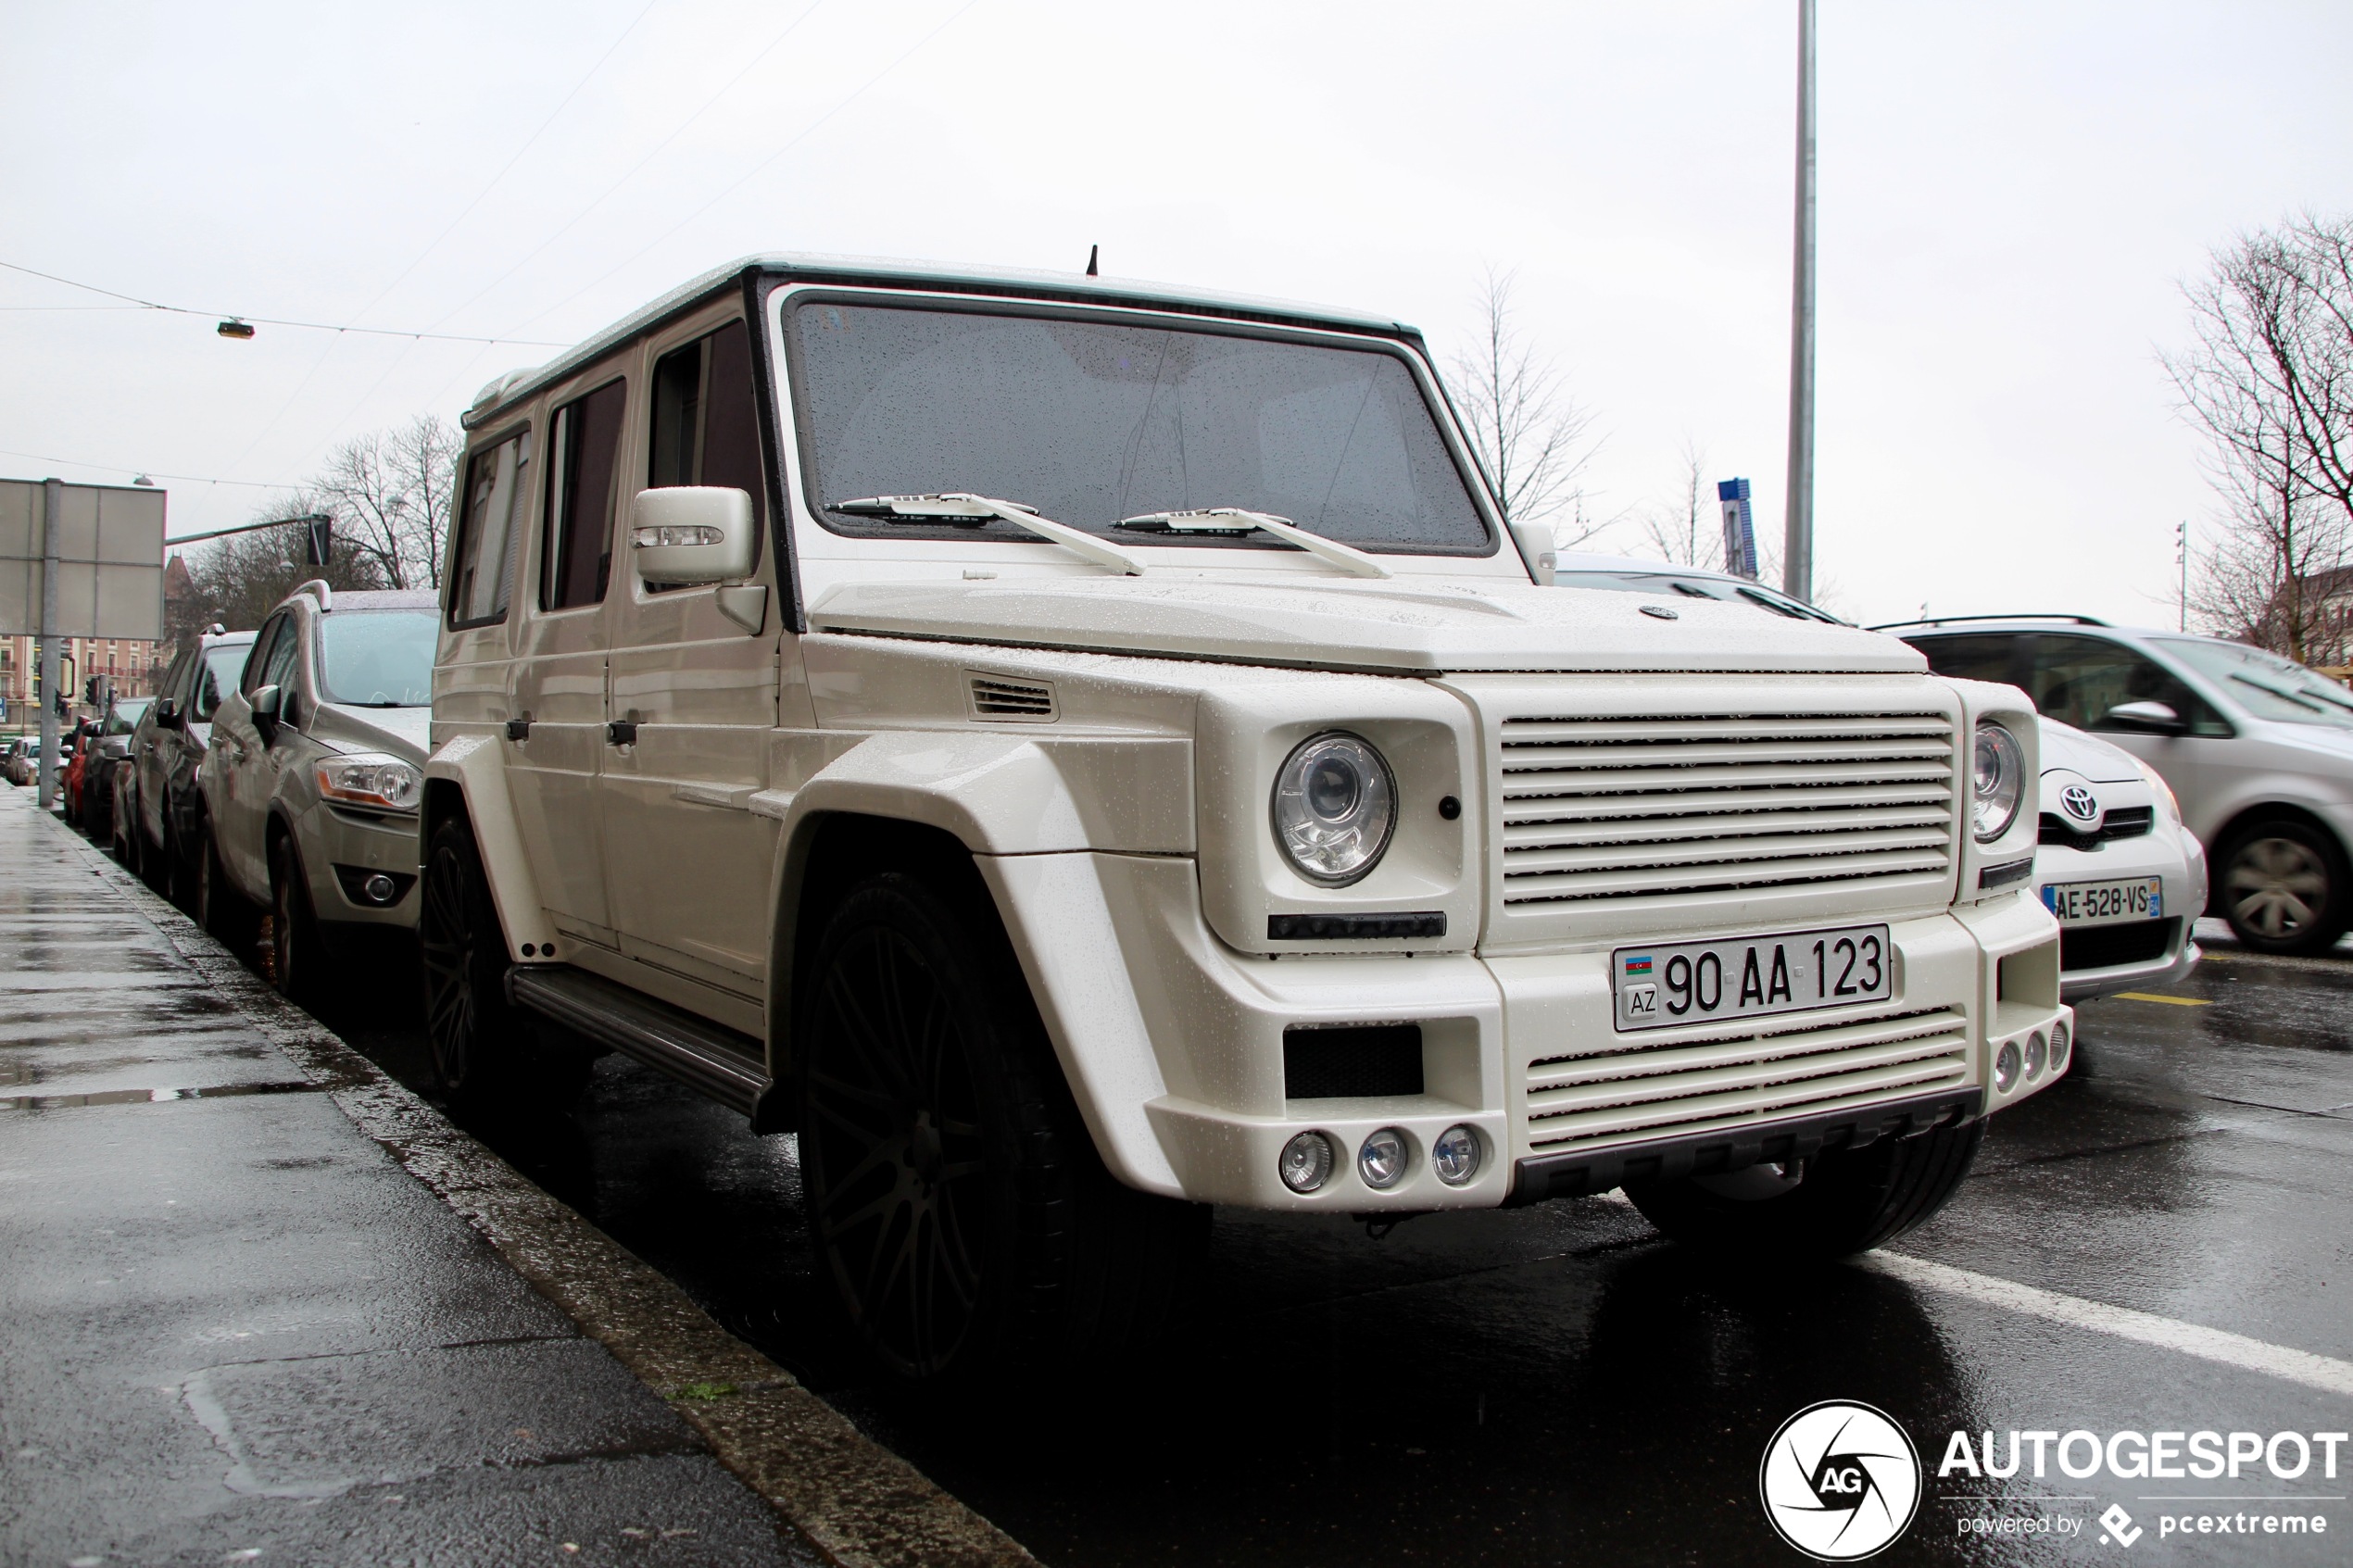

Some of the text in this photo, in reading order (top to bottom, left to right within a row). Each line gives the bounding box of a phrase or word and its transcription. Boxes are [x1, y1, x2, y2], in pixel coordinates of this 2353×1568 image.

[2056, 885, 2146, 920] AE-528-VS
[1666, 935, 1881, 1015] 90 AA 123
[1631, 991, 1655, 1013] AZ
